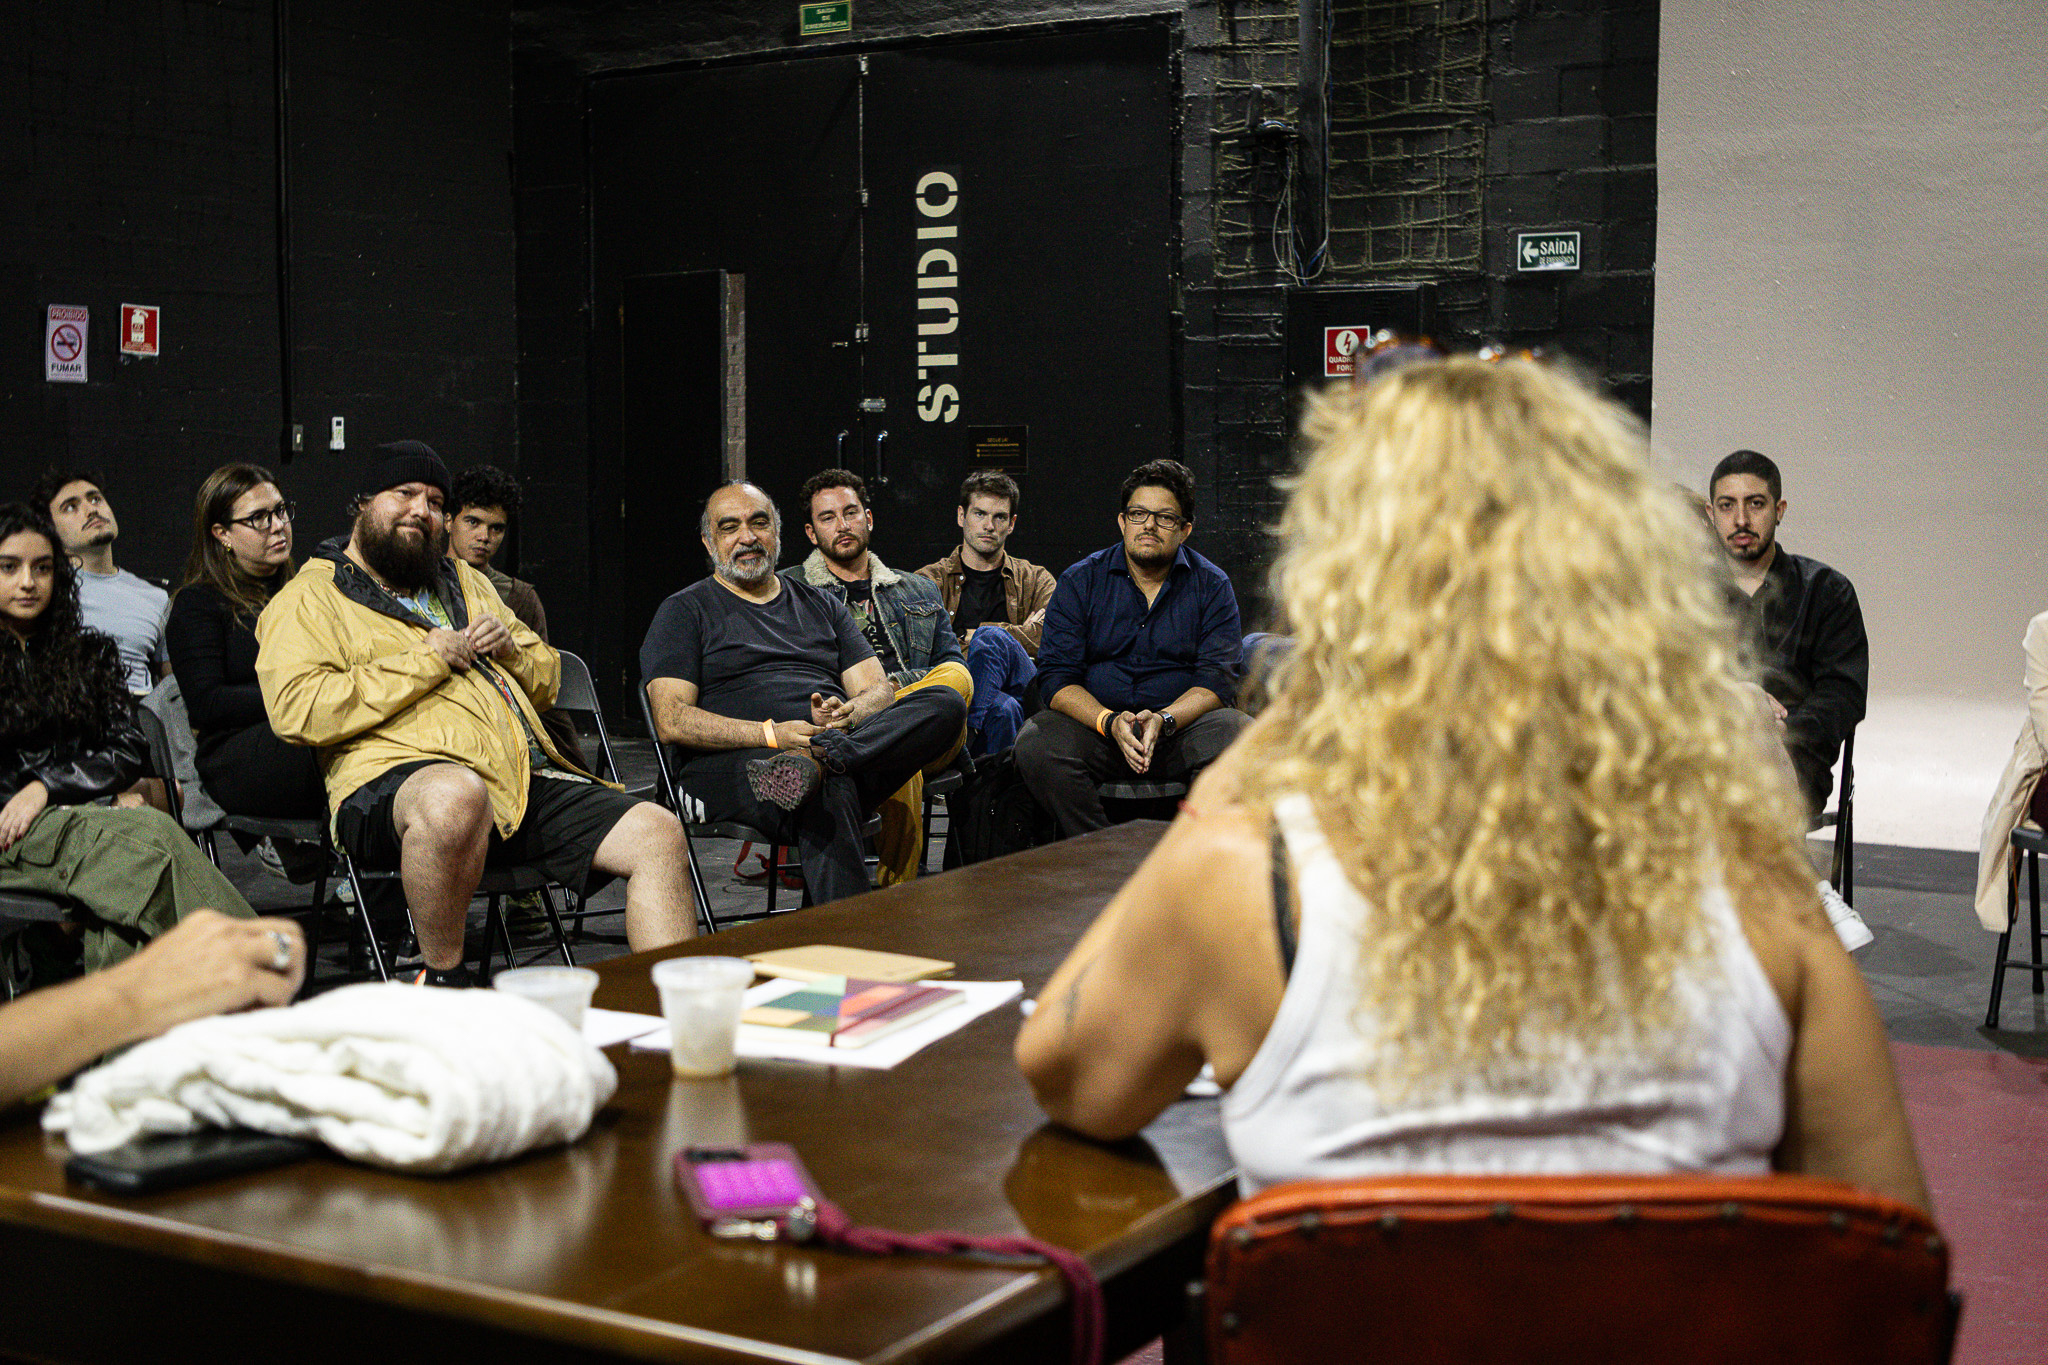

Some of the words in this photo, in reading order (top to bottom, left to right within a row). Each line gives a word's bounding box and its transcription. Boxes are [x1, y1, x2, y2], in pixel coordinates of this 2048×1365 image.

[1539, 238, 1576, 256] SAÍDA
[916, 171, 959, 423] STUDIO
[51, 309, 87, 321] PROIBIDO
[1328, 356, 1354, 364] QUADR
[51, 363, 82, 373] FUMAR
